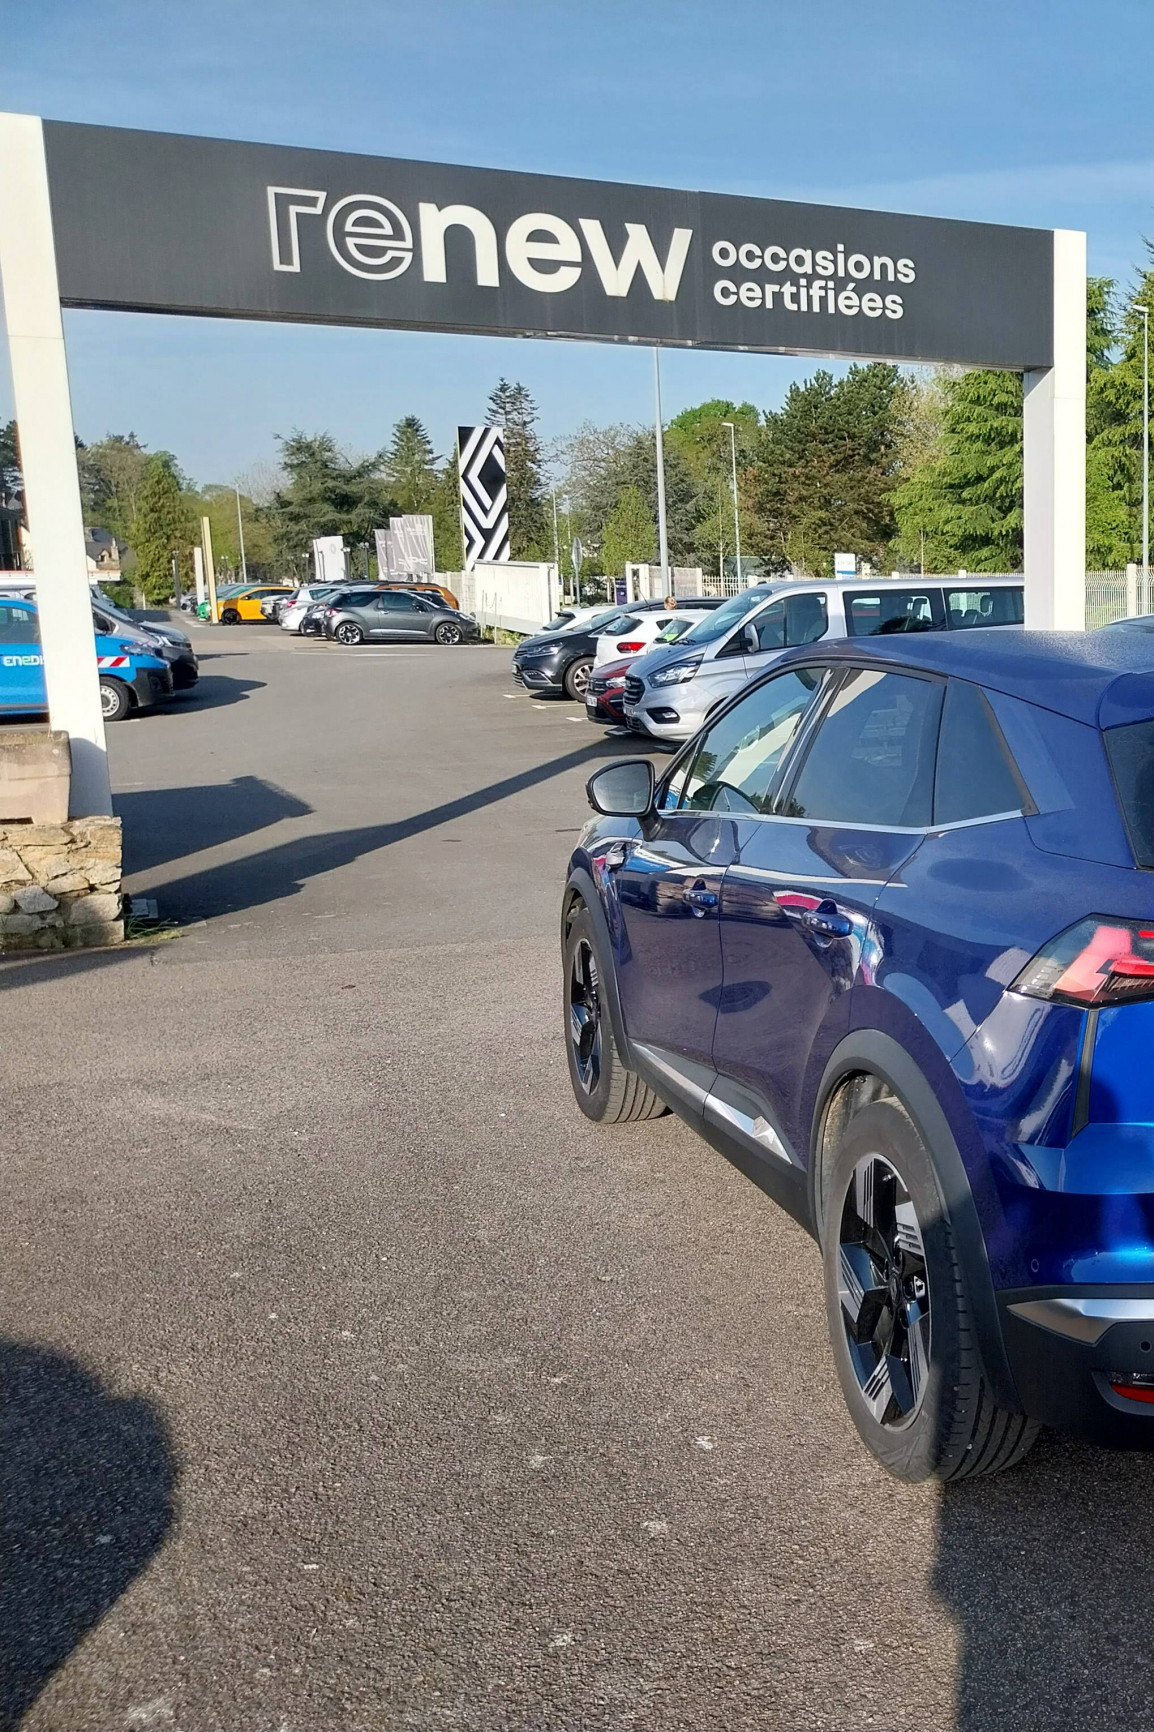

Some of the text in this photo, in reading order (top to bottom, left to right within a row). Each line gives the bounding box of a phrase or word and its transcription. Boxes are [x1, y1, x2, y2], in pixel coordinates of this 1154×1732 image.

[266, 185, 694, 302] renew
[711, 240, 917, 284] occasions
[712, 277, 904, 320] certifiées
